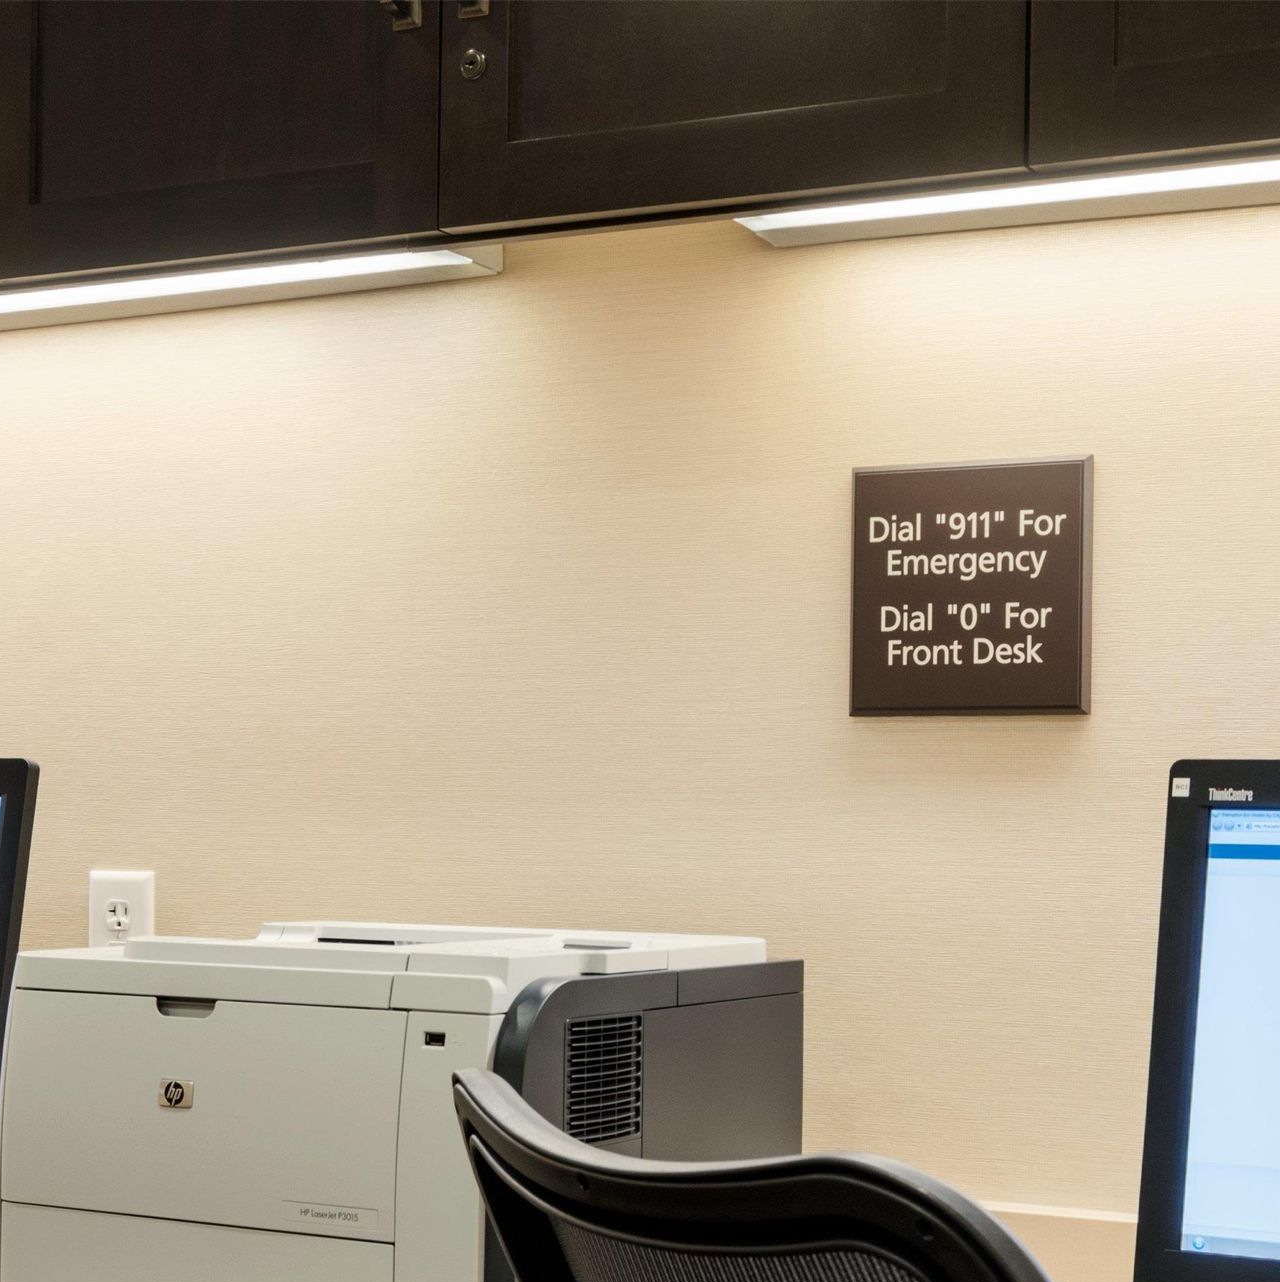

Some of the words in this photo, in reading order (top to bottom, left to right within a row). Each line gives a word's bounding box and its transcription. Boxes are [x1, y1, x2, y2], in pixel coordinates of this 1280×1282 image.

[869, 514, 921, 543] Dial
[936, 511, 1005, 540] "911"
[1019, 509, 1066, 537] For
[887, 550, 1047, 581] Emergency
[880, 603, 933, 632] Dial
[947, 603, 990, 630] "0"
[1005, 602, 1052, 628] For
[887, 640, 962, 666] Front
[973, 635, 1043, 664] Desk
[1208, 787, 1253, 801] ThinkCentre
[300, 1208, 310, 1217] HP
[311, 1210, 336, 1220] LaserJet
[338, 1212, 359, 1222] P3015
